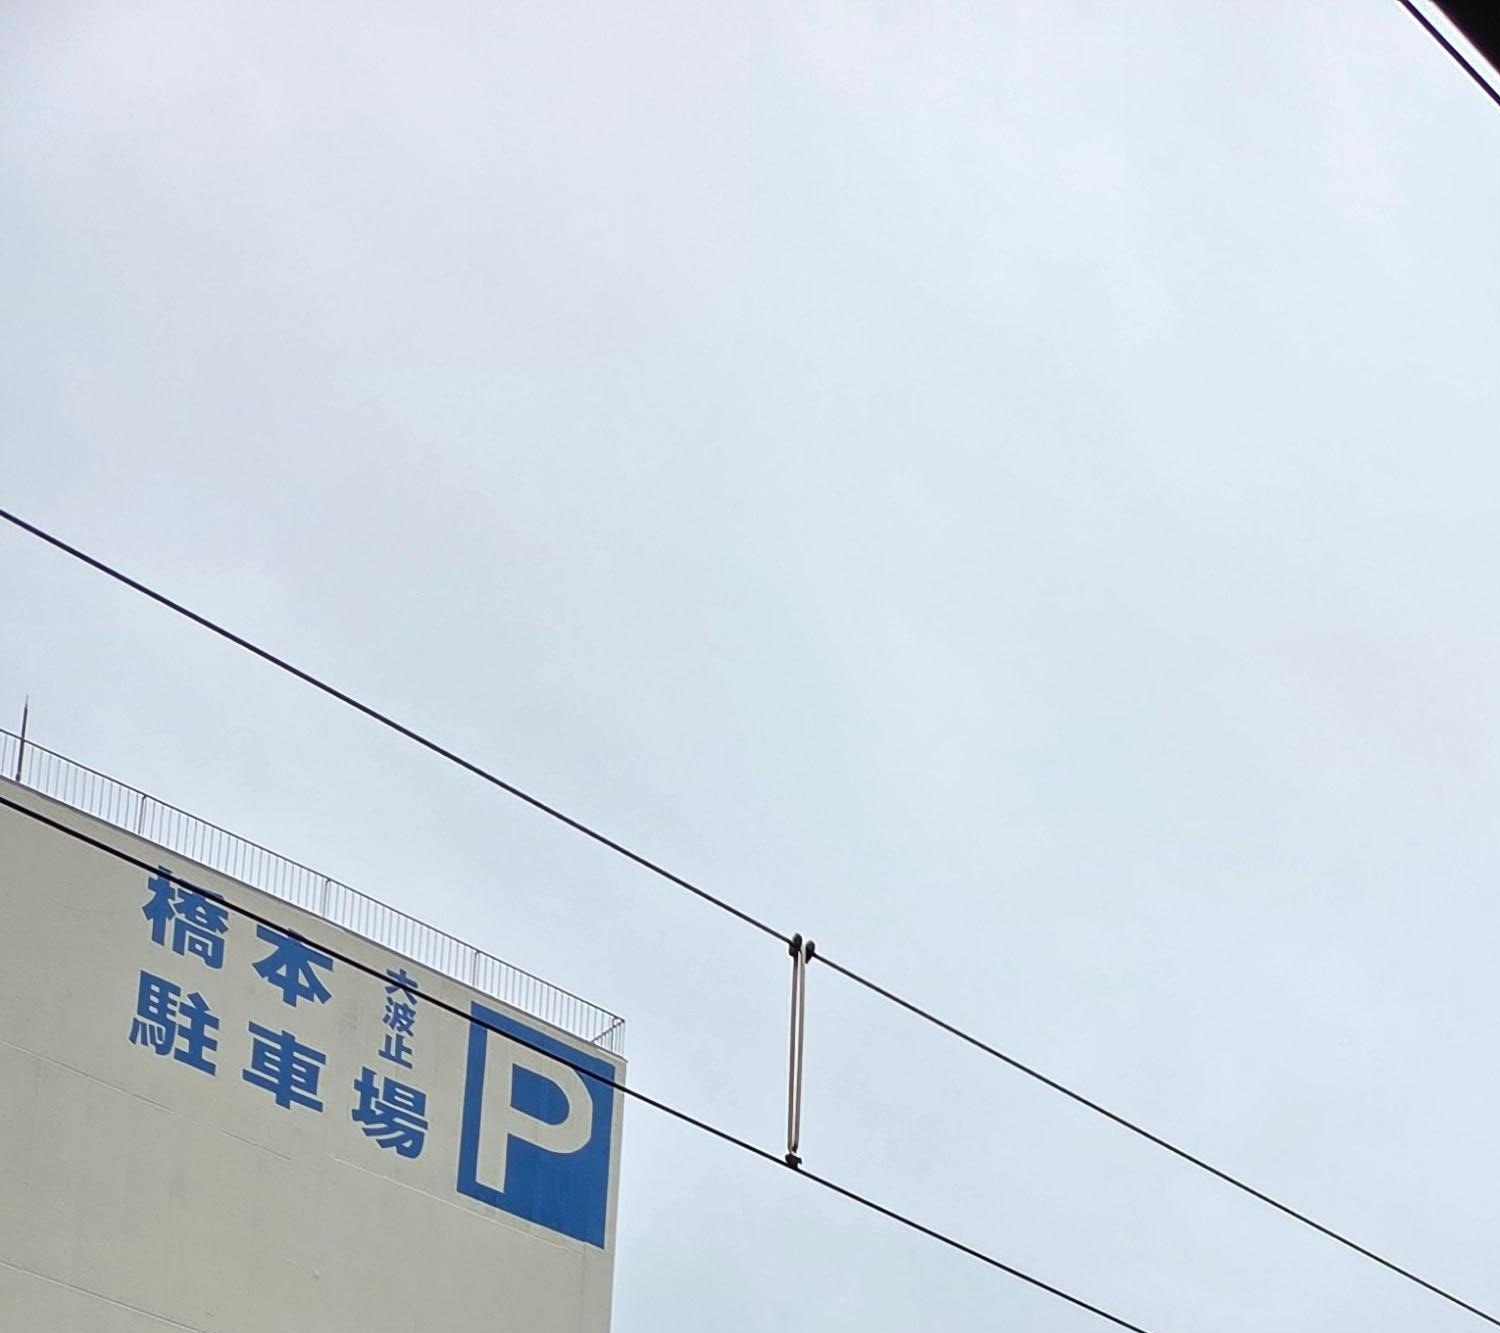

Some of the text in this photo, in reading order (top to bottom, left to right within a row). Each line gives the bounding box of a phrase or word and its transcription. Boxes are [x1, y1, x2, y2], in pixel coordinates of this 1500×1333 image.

[142, 865, 334, 1008] 橋本
[127, 969, 430, 1160] 駐車場
[378, 967, 419, 1070] 大波止
[474, 1023, 594, 1194] P
